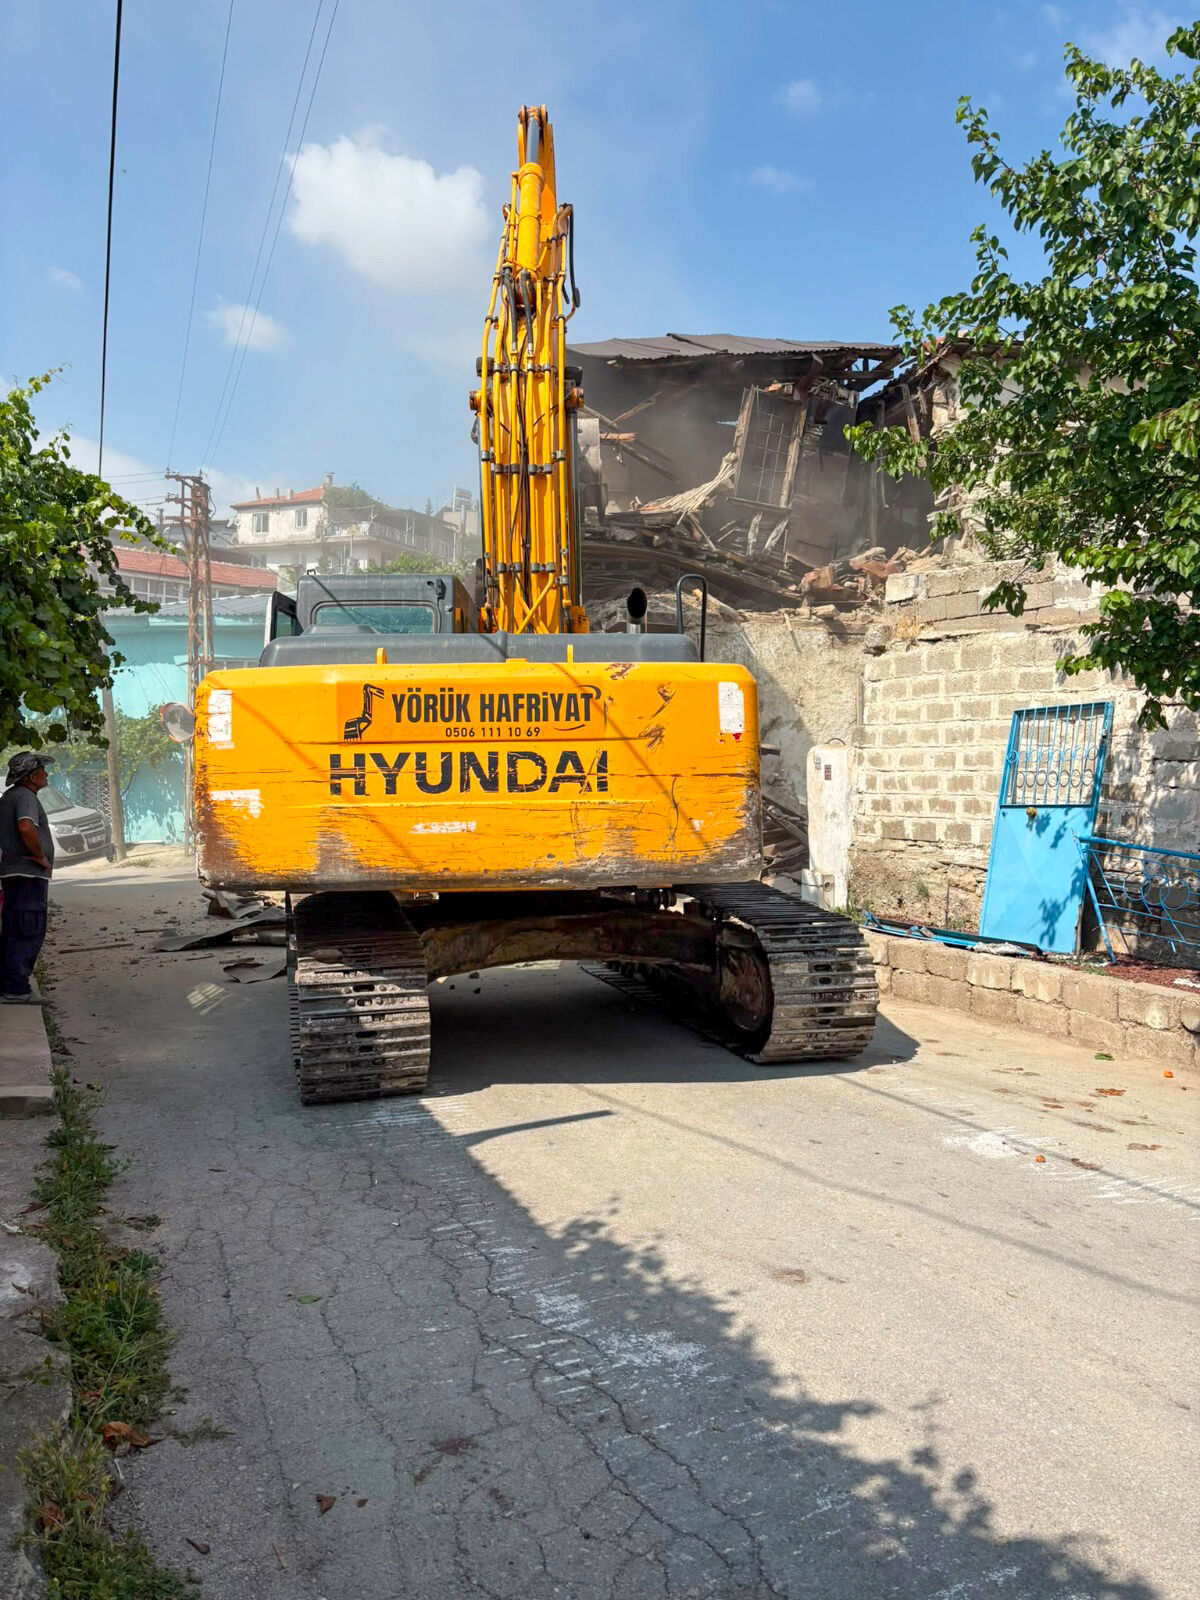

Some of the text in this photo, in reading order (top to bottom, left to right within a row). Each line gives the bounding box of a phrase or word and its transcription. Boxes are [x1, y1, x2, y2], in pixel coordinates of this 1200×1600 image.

[391, 687, 471, 723] YÖRÜK
[445, 727, 541, 738] 0506 111 10 69
[329, 750, 609, 796] HYUNDAI
